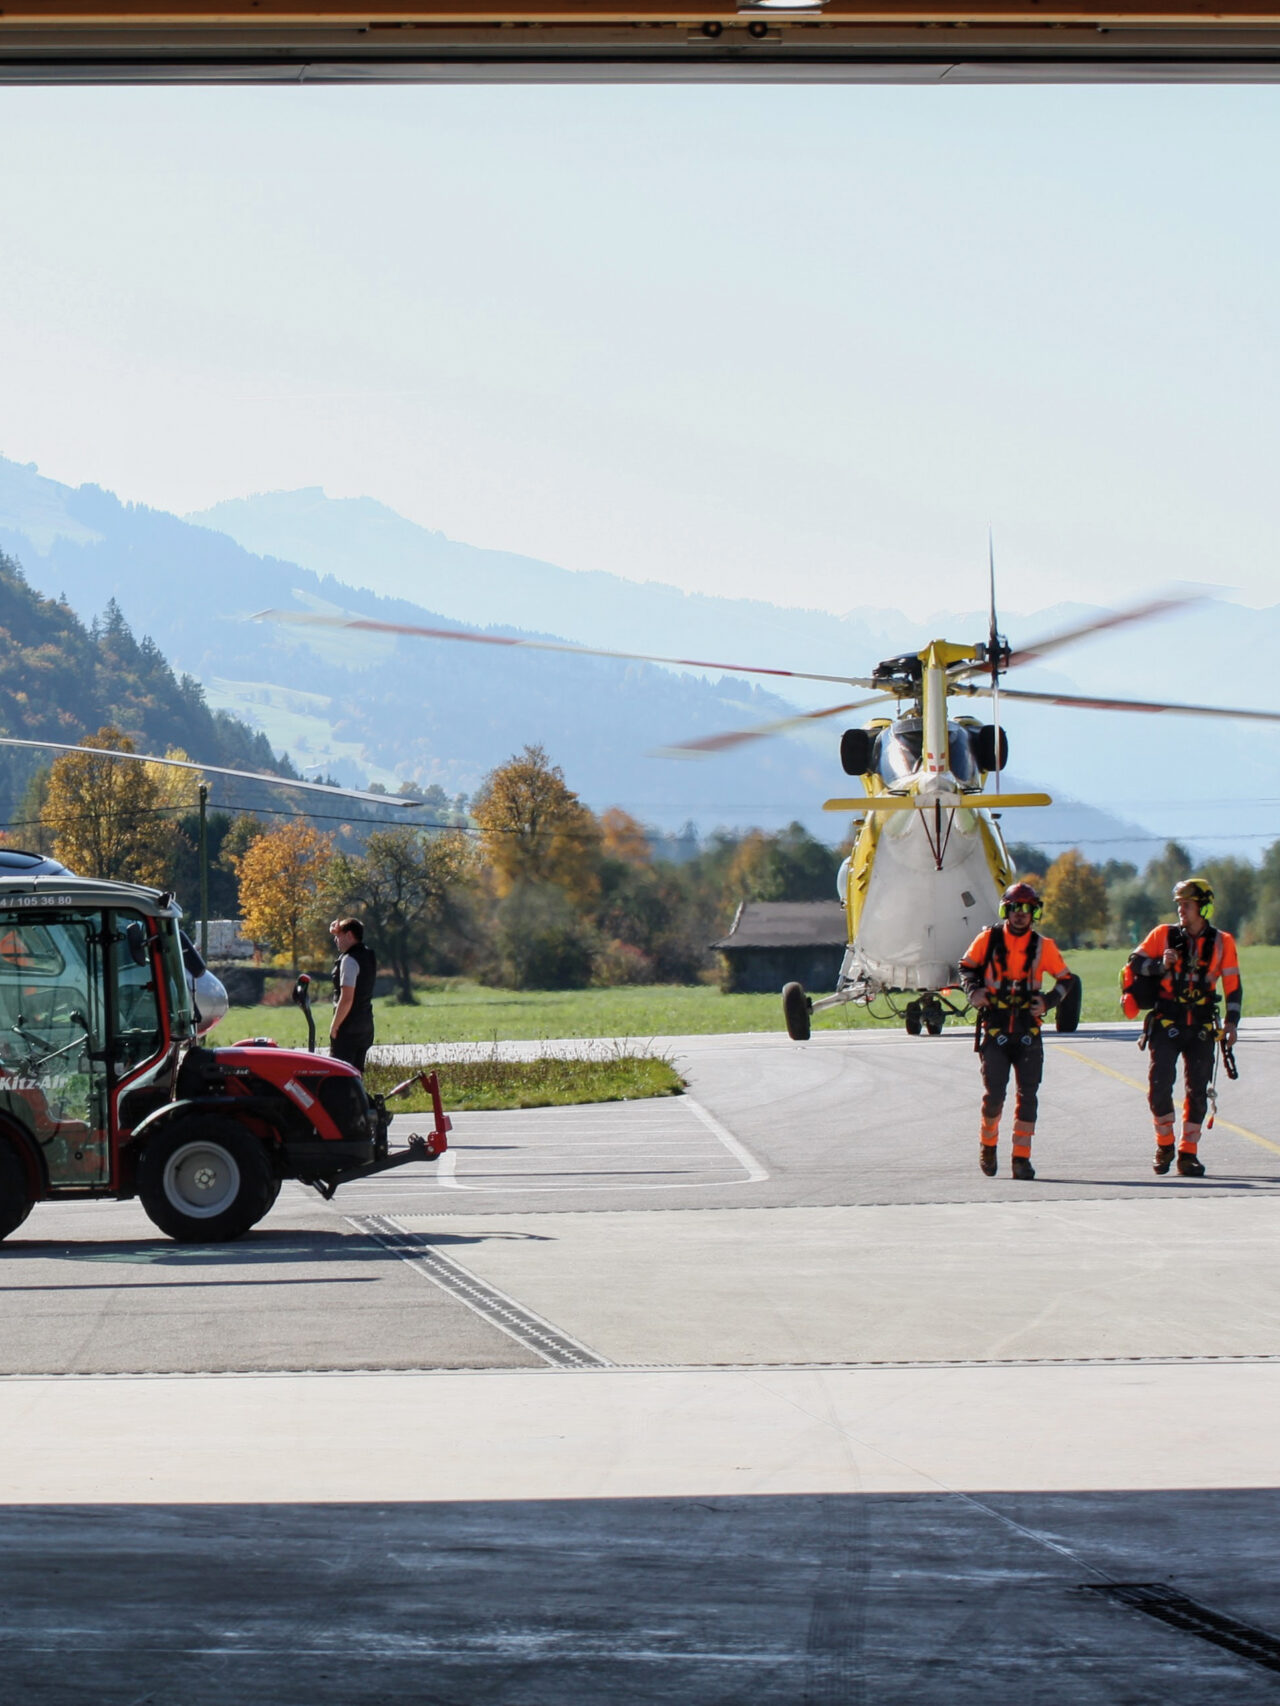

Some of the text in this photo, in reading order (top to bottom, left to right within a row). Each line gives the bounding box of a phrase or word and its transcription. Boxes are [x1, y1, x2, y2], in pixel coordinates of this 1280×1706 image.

[18, 896, 38, 907] 105
[41, 896, 55, 906] 36
[58, 896, 72, 905] 80
